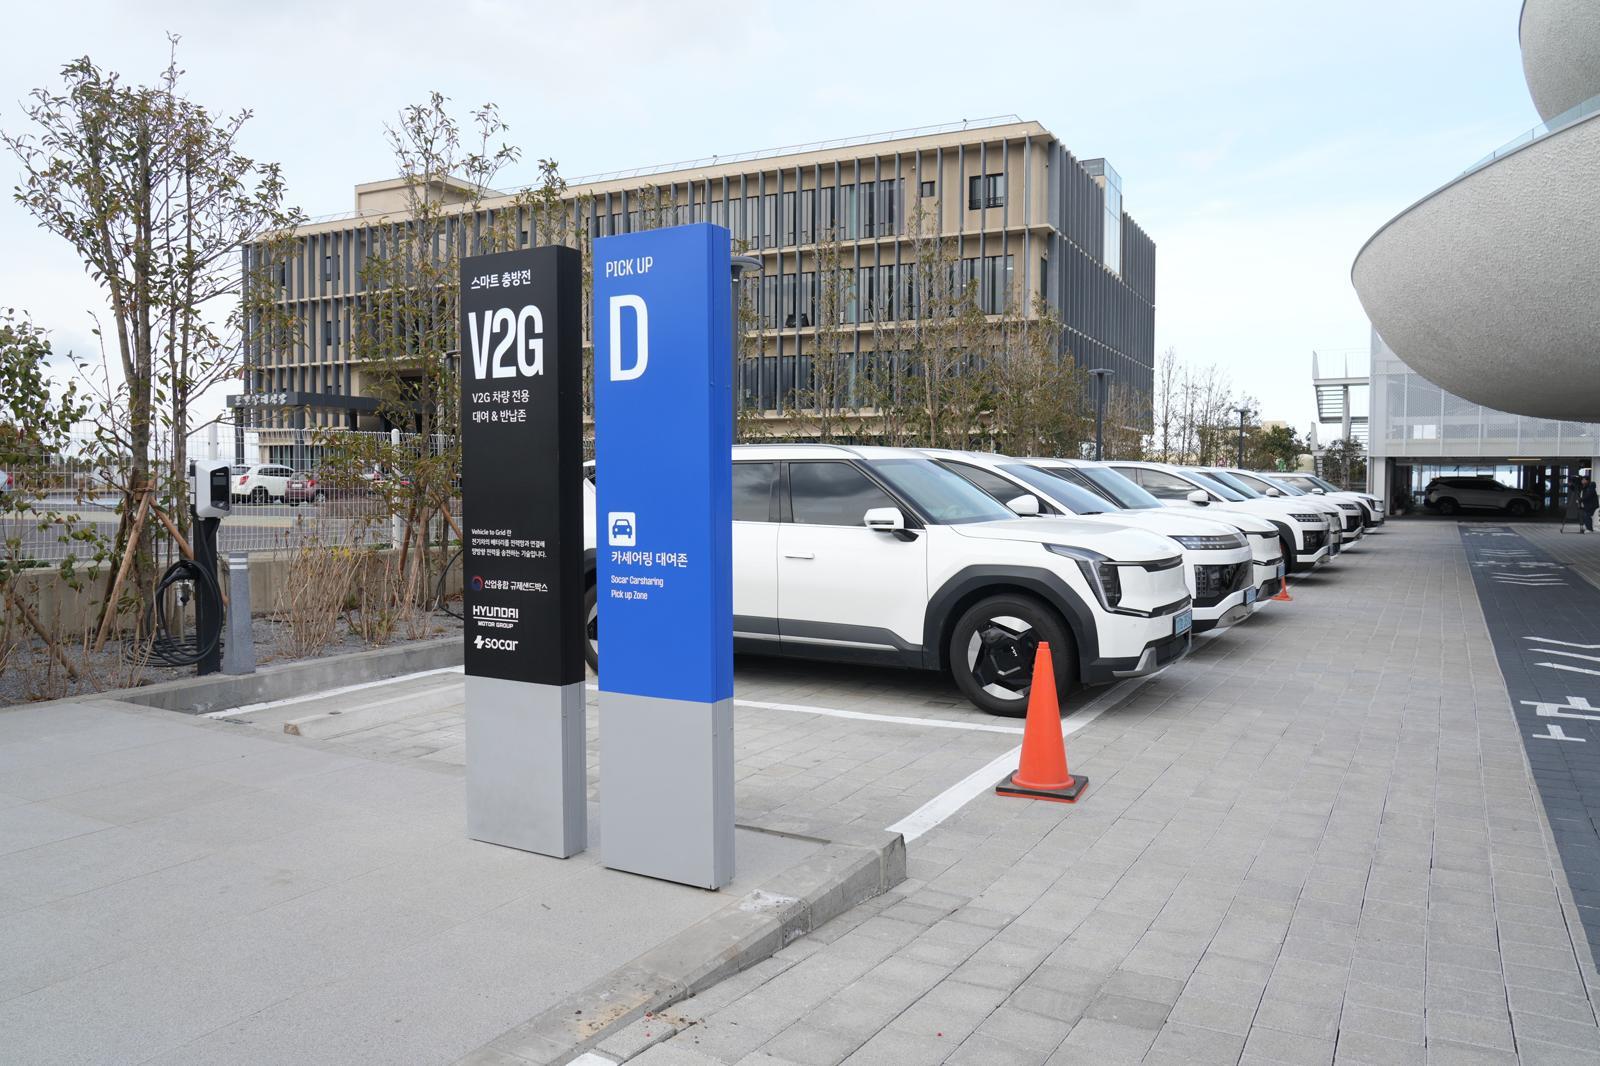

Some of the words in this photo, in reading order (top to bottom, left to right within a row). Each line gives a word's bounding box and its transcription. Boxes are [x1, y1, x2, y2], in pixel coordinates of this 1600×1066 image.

[605, 258, 634, 278] PICK
[636, 256, 653, 274] UP
[471, 274, 499, 290] 스마트
[501, 269, 531, 288] 충방전
[468, 304, 544, 380] V2G
[609, 294, 649, 382] D
[472, 392, 491, 404] V2G
[492, 390, 510, 404] 차량
[511, 389, 530, 403] 전용
[472, 410, 489, 424] 대여
[491, 411, 498, 422] &
[499, 409, 527, 423] 반납존
[656, 552, 688, 567] 대여존
[611, 575, 628, 583] Socar
[630, 576, 664, 587] Carsharing
[611, 589, 623, 598] Pick
[624, 591, 633, 600] up
[633, 590, 648, 600] Zone
[472, 605, 518, 619] HYUNDAI
